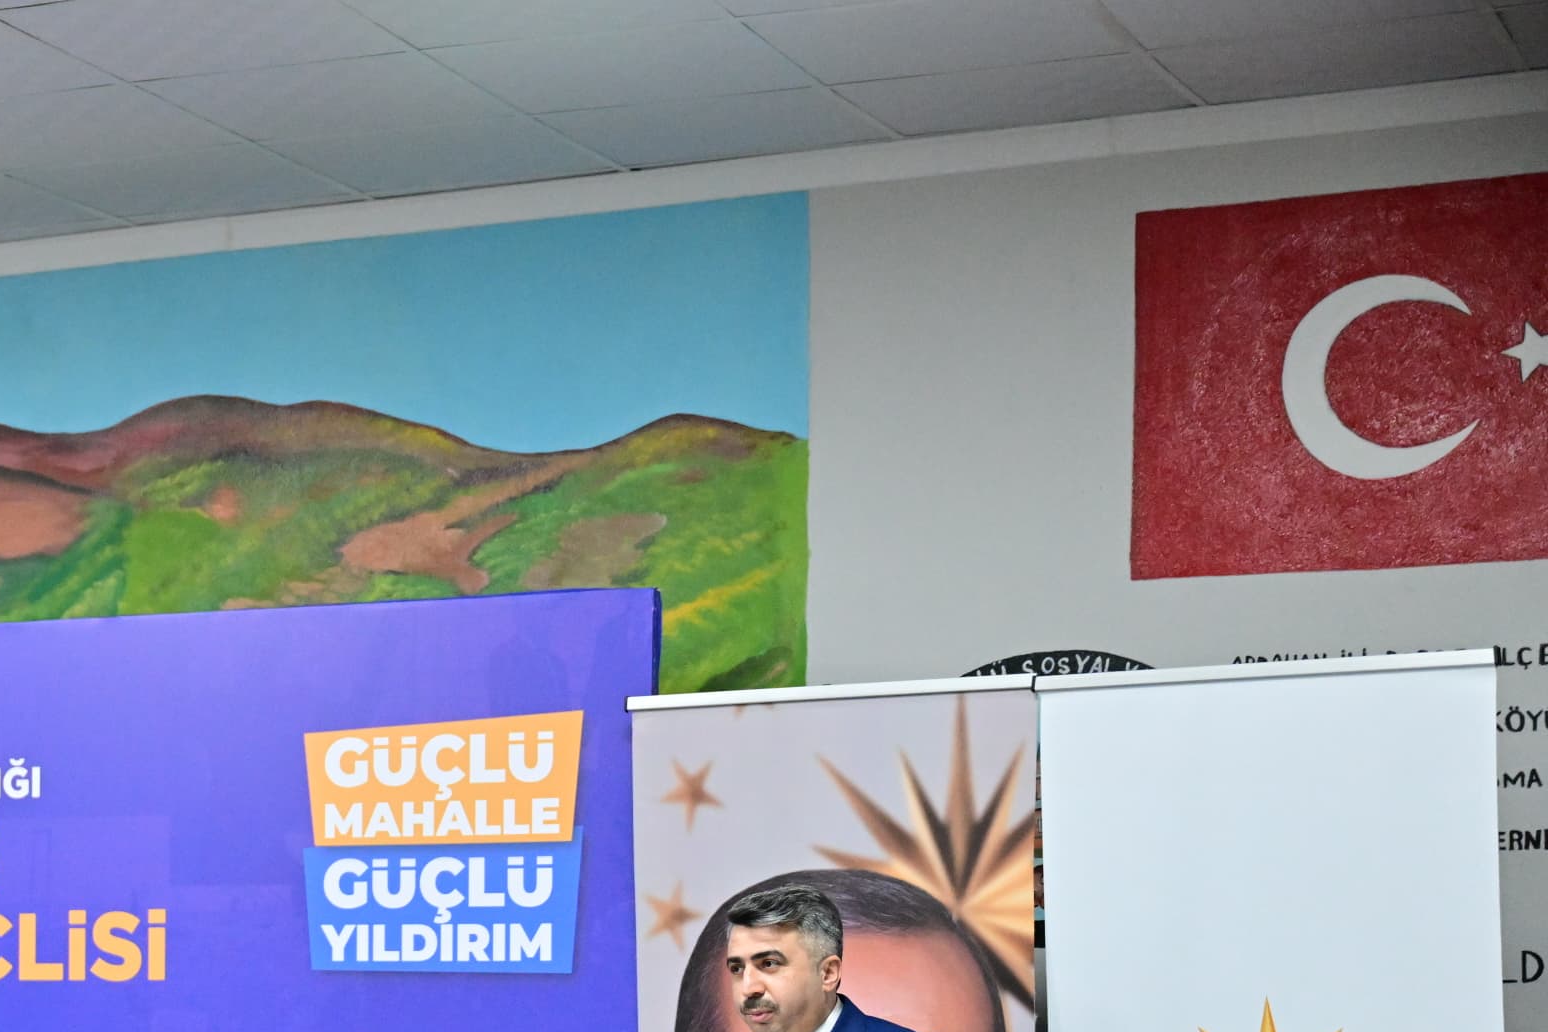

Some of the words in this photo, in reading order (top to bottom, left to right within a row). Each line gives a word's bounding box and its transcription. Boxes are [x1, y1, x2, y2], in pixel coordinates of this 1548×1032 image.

[324, 731, 554, 800] GÜÇLÜ
[324, 797, 560, 839] MAHALLE
[323, 856, 553, 924] GÜÇLÜ
[320, 922, 553, 963] YILDIRIM
